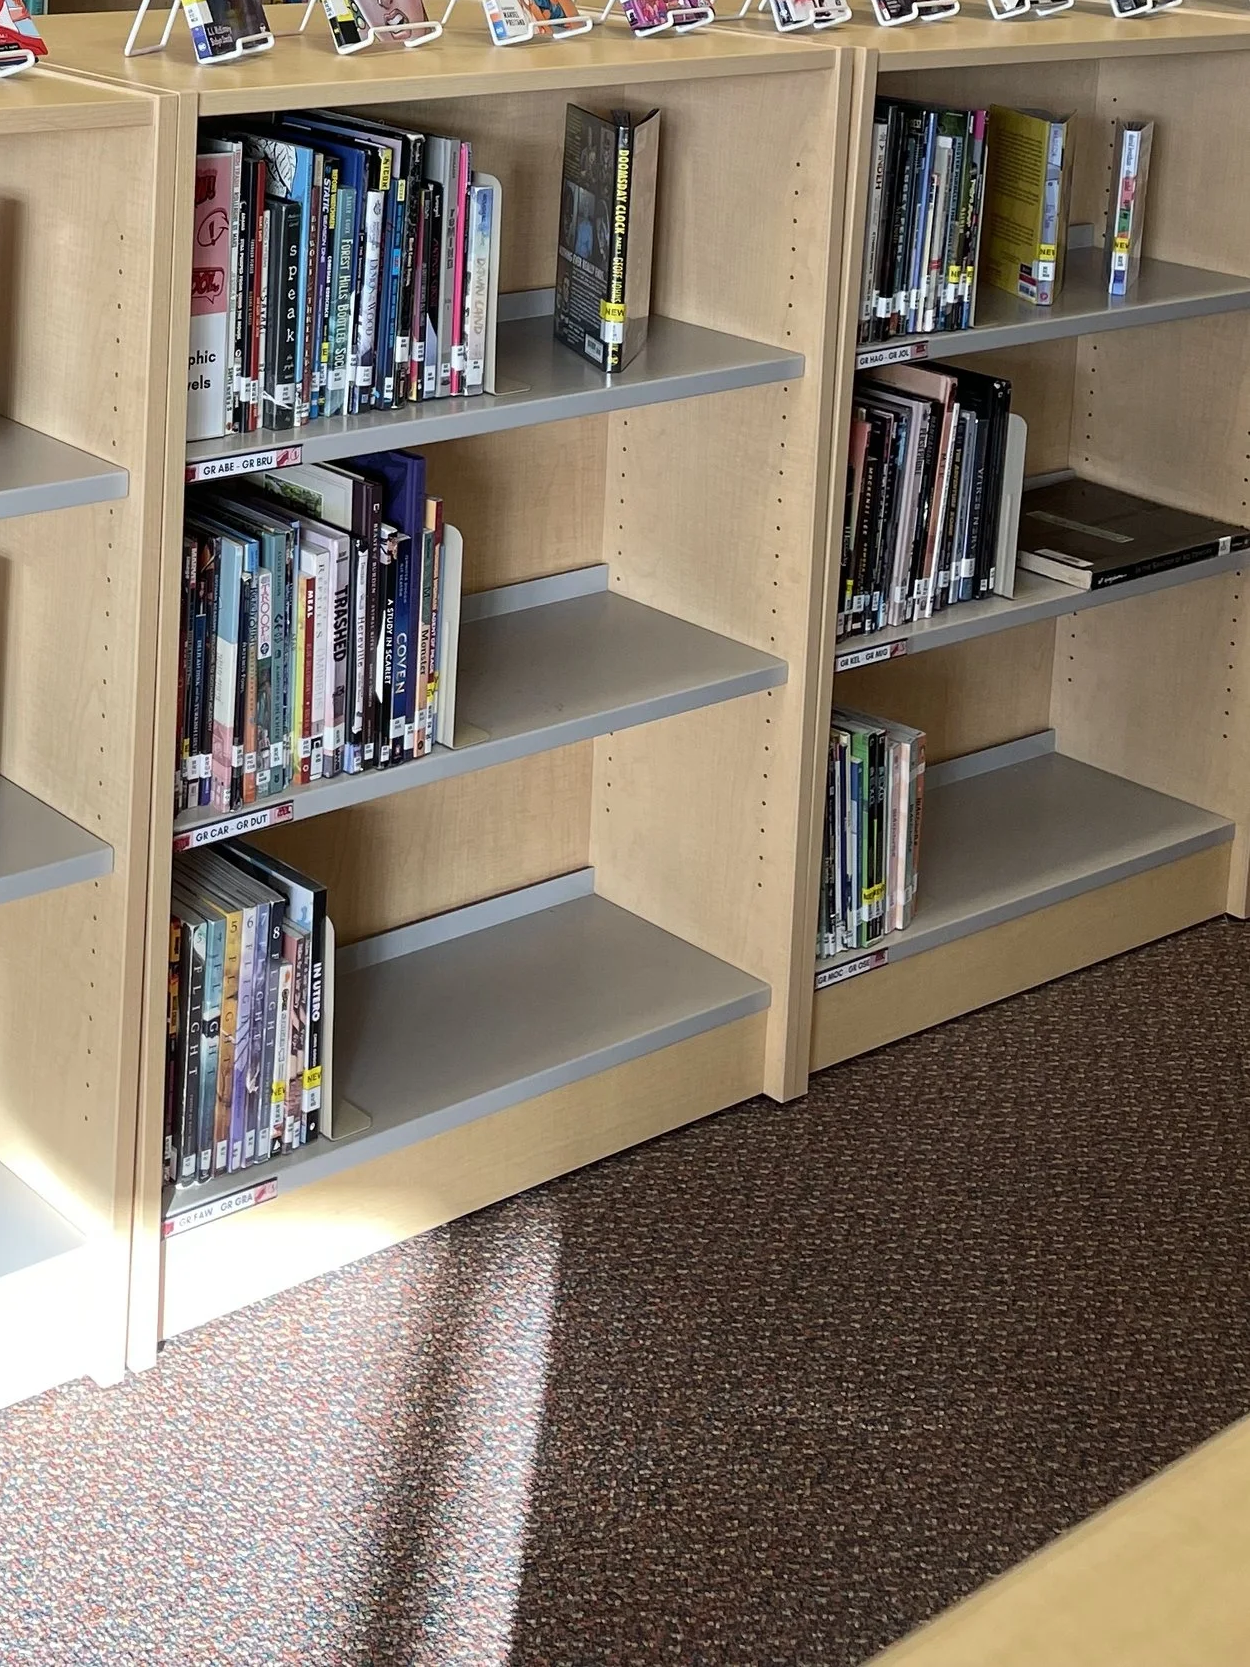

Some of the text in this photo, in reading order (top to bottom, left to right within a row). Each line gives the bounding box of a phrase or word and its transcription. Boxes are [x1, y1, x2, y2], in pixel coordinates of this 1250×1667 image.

[322, 178, 331, 214] STATIC
[616, 149, 629, 235] DOOMSDAY CLOCK
[901, 165, 910, 211] LUCKY
[285, 244, 297, 344] speak
[335, 239, 353, 343] FOREST HILLS BOOTLEG
[365, 302, 376, 336] WOOD
[606, 308, 625, 316] NEW
[859, 349, 909, 365] GR HAG GR JOL
[203, 455, 272, 475] GR ABE GR BRU
[951, 464, 959, 508] ADVENTURE
[306, 590, 314, 619] MEAL
[333, 585, 348, 662] TRASHED
[356, 616, 366, 668] Hereville
[386, 636, 392, 647] IN
[420, 629, 429, 676] Monster
[840, 647, 888, 667] GR GR MIG
[384, 649, 392, 684] SCARLET
[394, 632, 407, 694] COVEN
[196, 814, 267, 842] GR CAR GR DUT
[246, 916, 254, 929] 6
[223, 920, 238, 1063] 5 FLIGHT
[266, 926, 280, 1048] 8 FLIGHT
[311, 962, 322, 1022] IN UTERO
[818, 970, 844, 984] GR MOC
[189, 965, 202, 1076] FLIGHT
[207, 964, 222, 1076] FLIGHT
[307, 1072, 323, 1083] NEW
[221, 1194, 253, 1211] GR GRA
